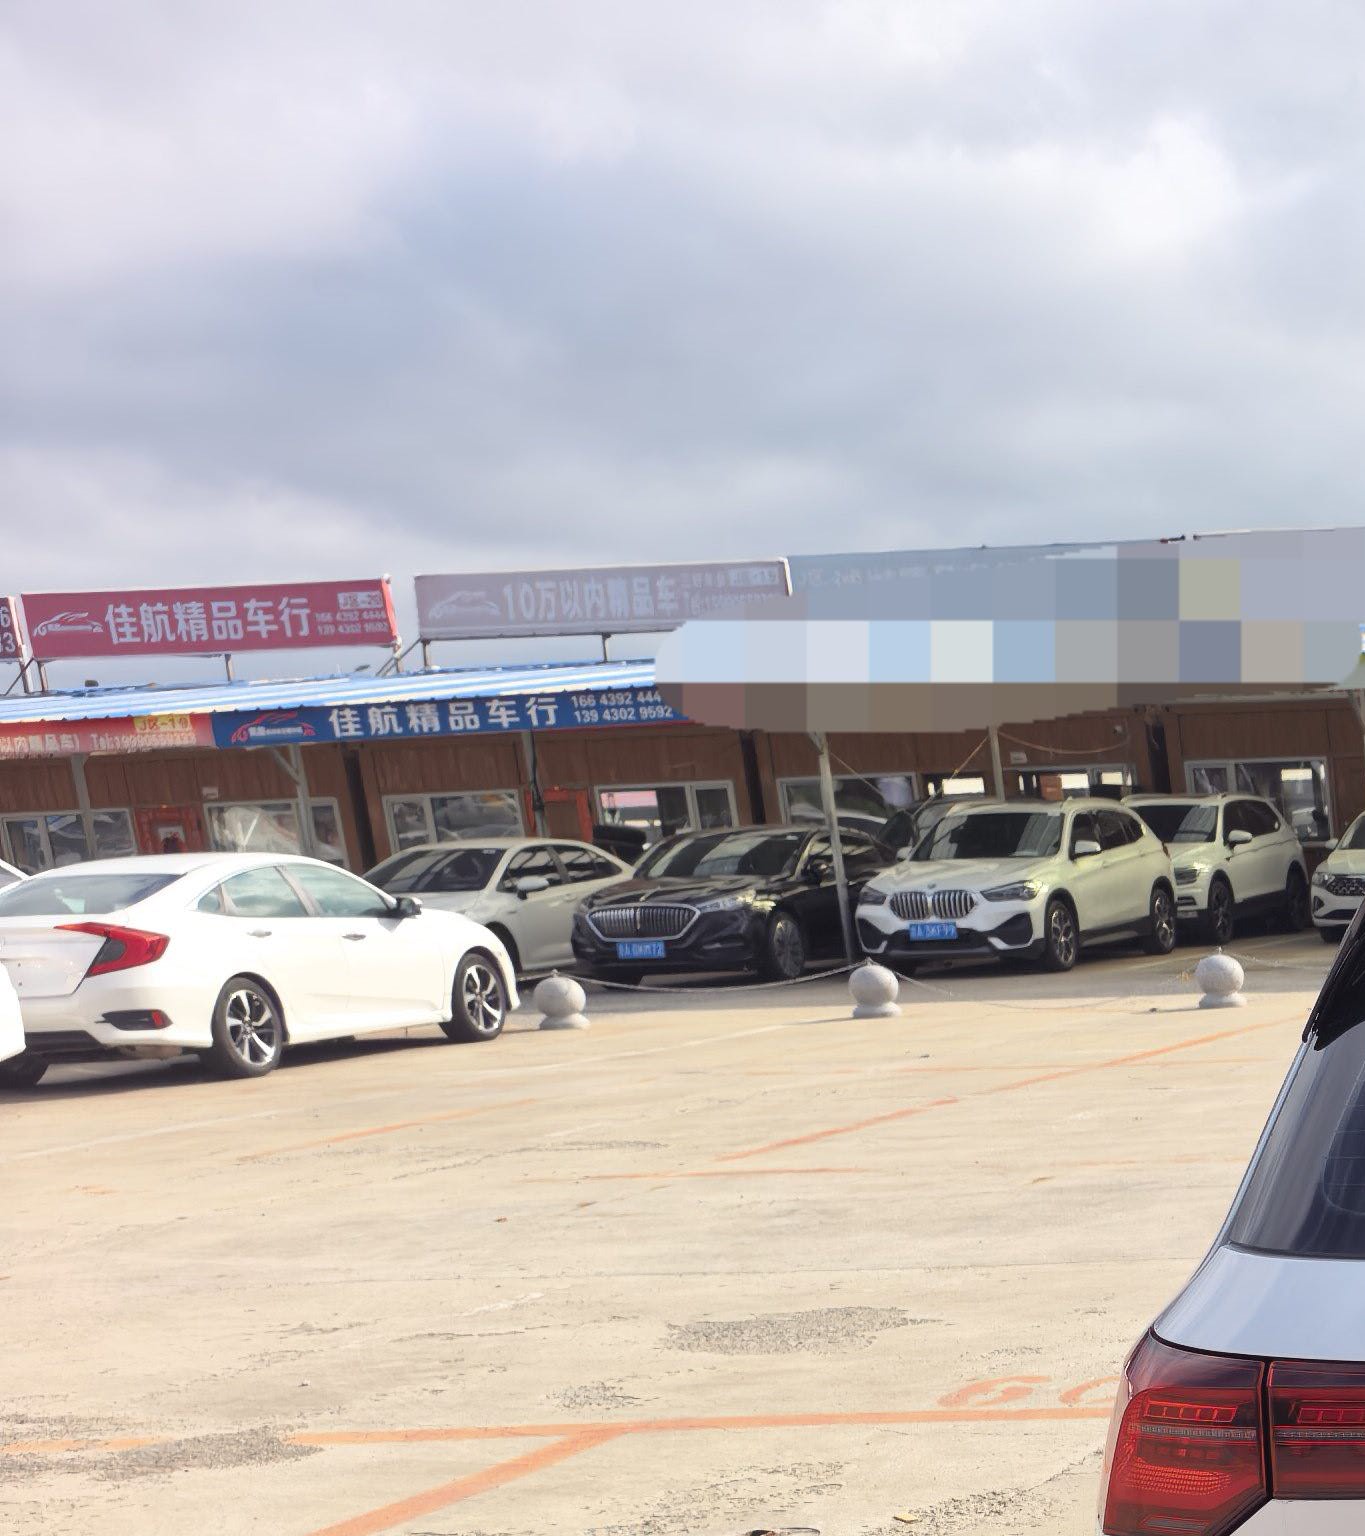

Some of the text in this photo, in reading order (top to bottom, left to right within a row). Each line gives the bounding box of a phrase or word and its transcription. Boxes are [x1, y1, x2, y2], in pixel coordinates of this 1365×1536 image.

[105, 597, 311, 644] 佳航精品车行
[329, 697, 558, 737] 佳航精品车行
